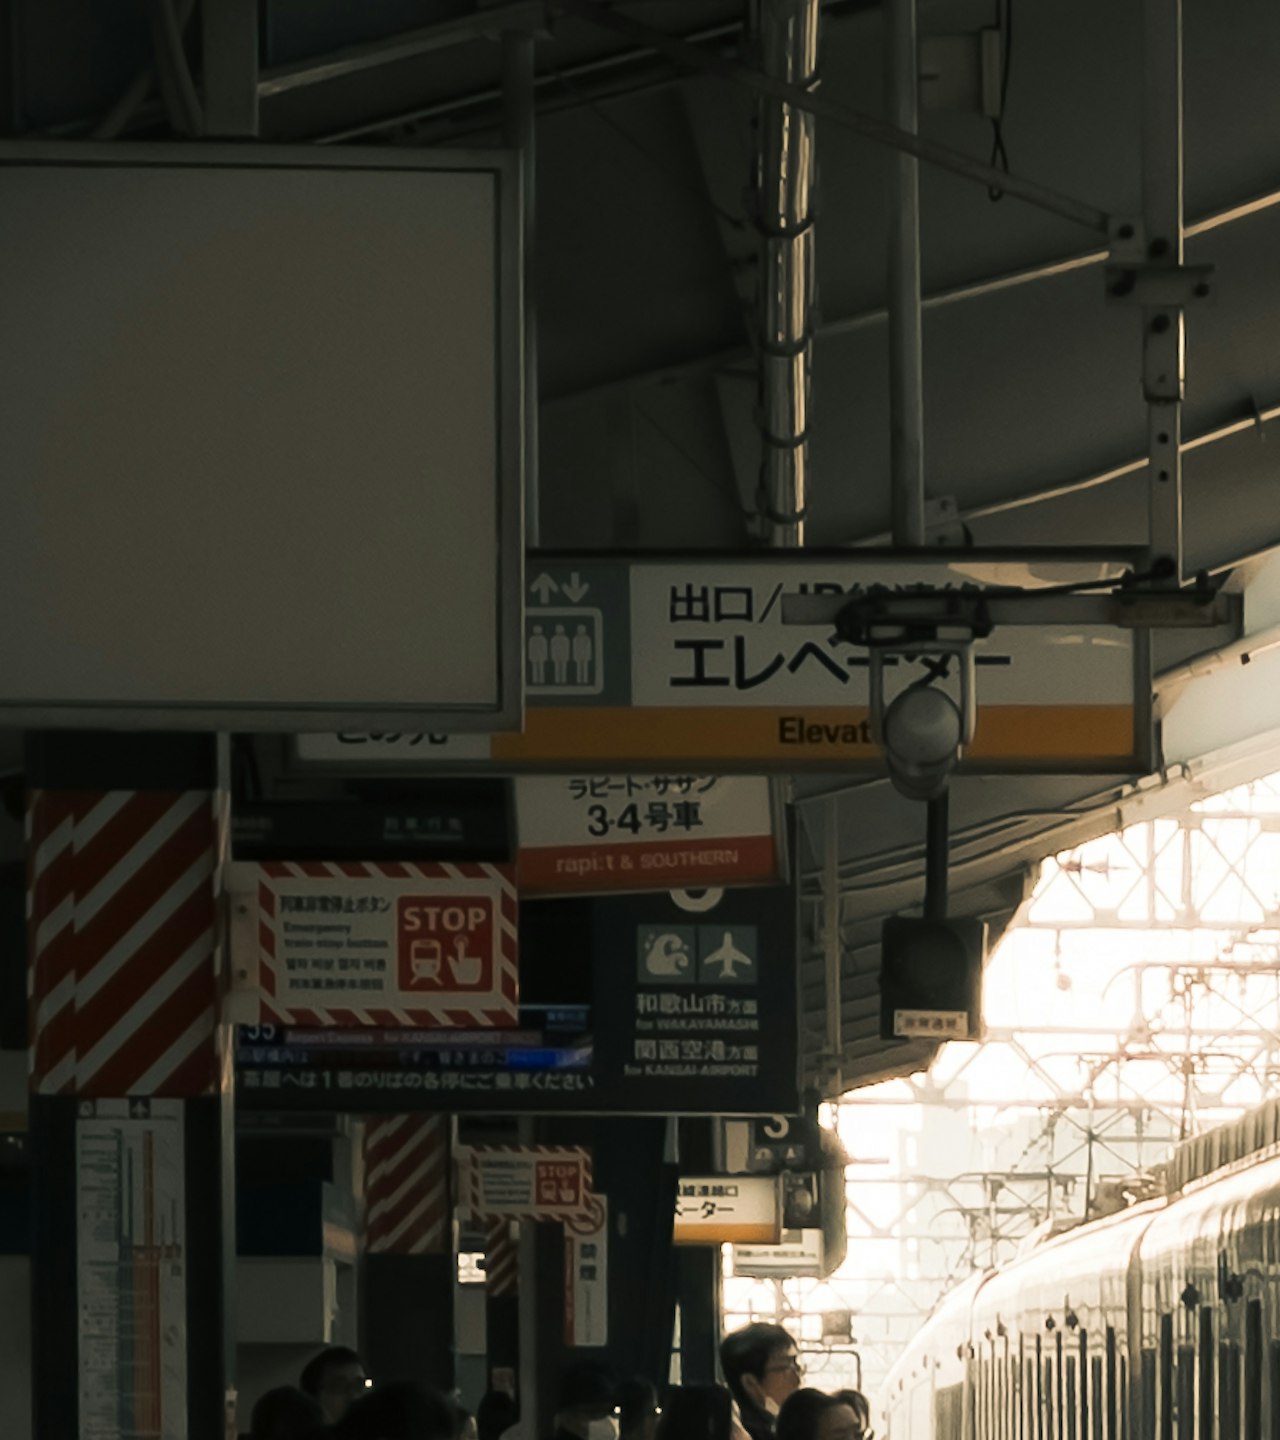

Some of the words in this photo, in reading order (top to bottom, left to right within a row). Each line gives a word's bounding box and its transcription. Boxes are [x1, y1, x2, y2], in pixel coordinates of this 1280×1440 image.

[620, 854, 633, 870] &
[640, 849, 739, 869] SOUTHERN
[404, 906, 486, 931] STOP
[283, 921, 351, 934] Emergency
[636, 1018, 654, 1030] for
[656, 1018, 759, 1031] WAKAYAMASHI
[624, 1064, 642, 1076] for
[538, 1166, 577, 1178] STOP
